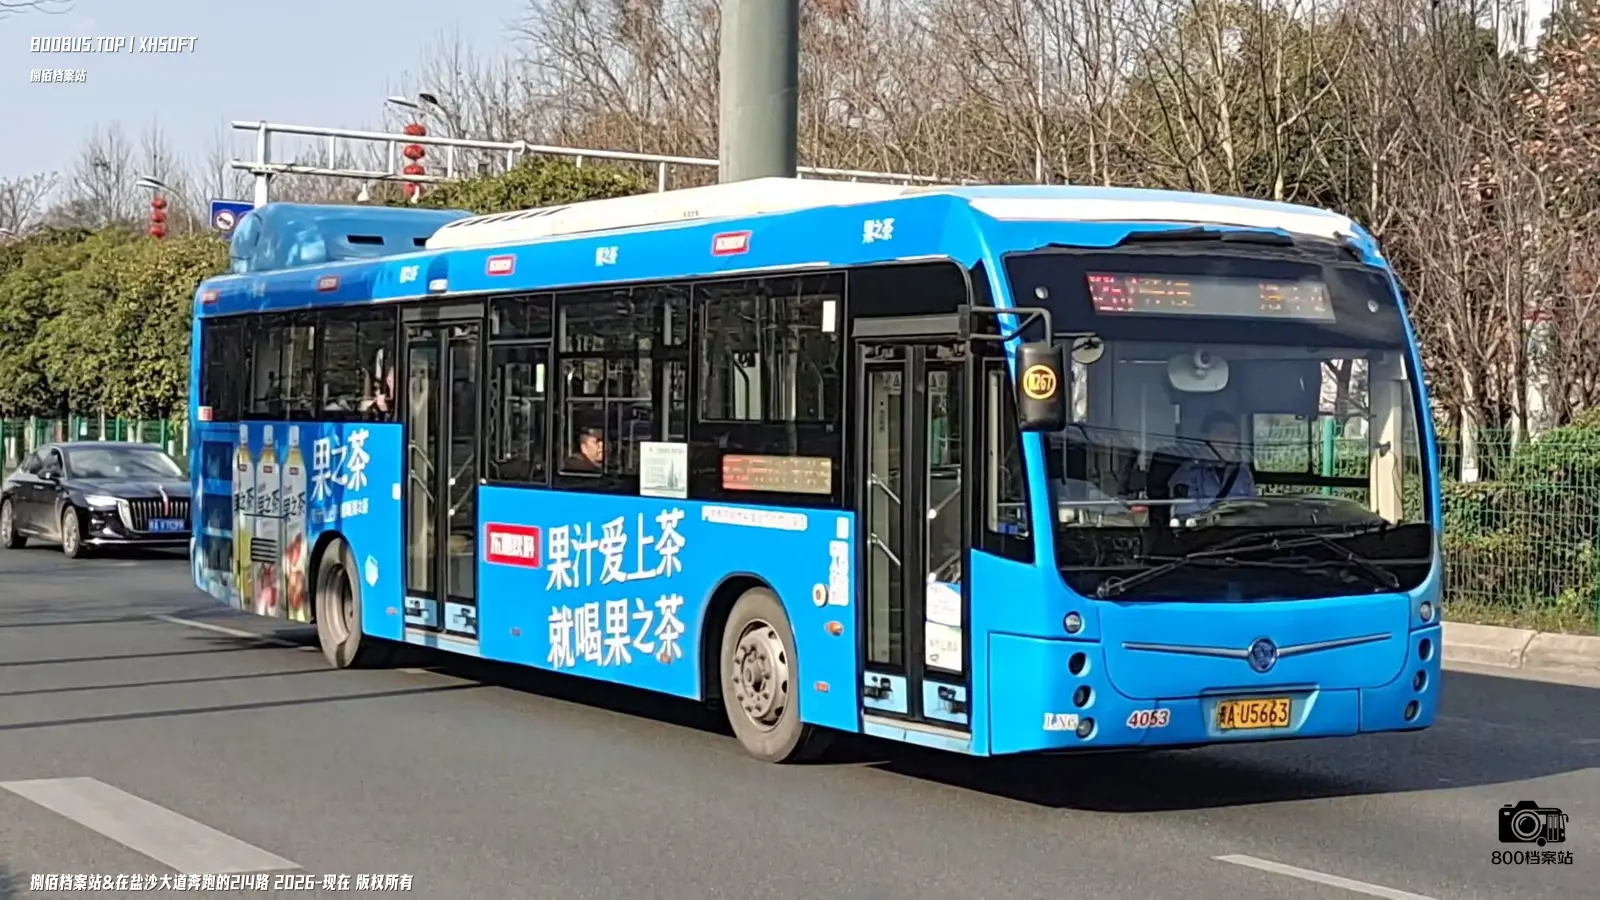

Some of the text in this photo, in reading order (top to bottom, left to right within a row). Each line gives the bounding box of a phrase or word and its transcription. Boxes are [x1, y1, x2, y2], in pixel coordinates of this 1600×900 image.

[310, 428, 370, 500] 果之茶
[545, 507, 686, 591] 果汁爱上茶
[547, 593, 685, 670] 就喝果之茶
